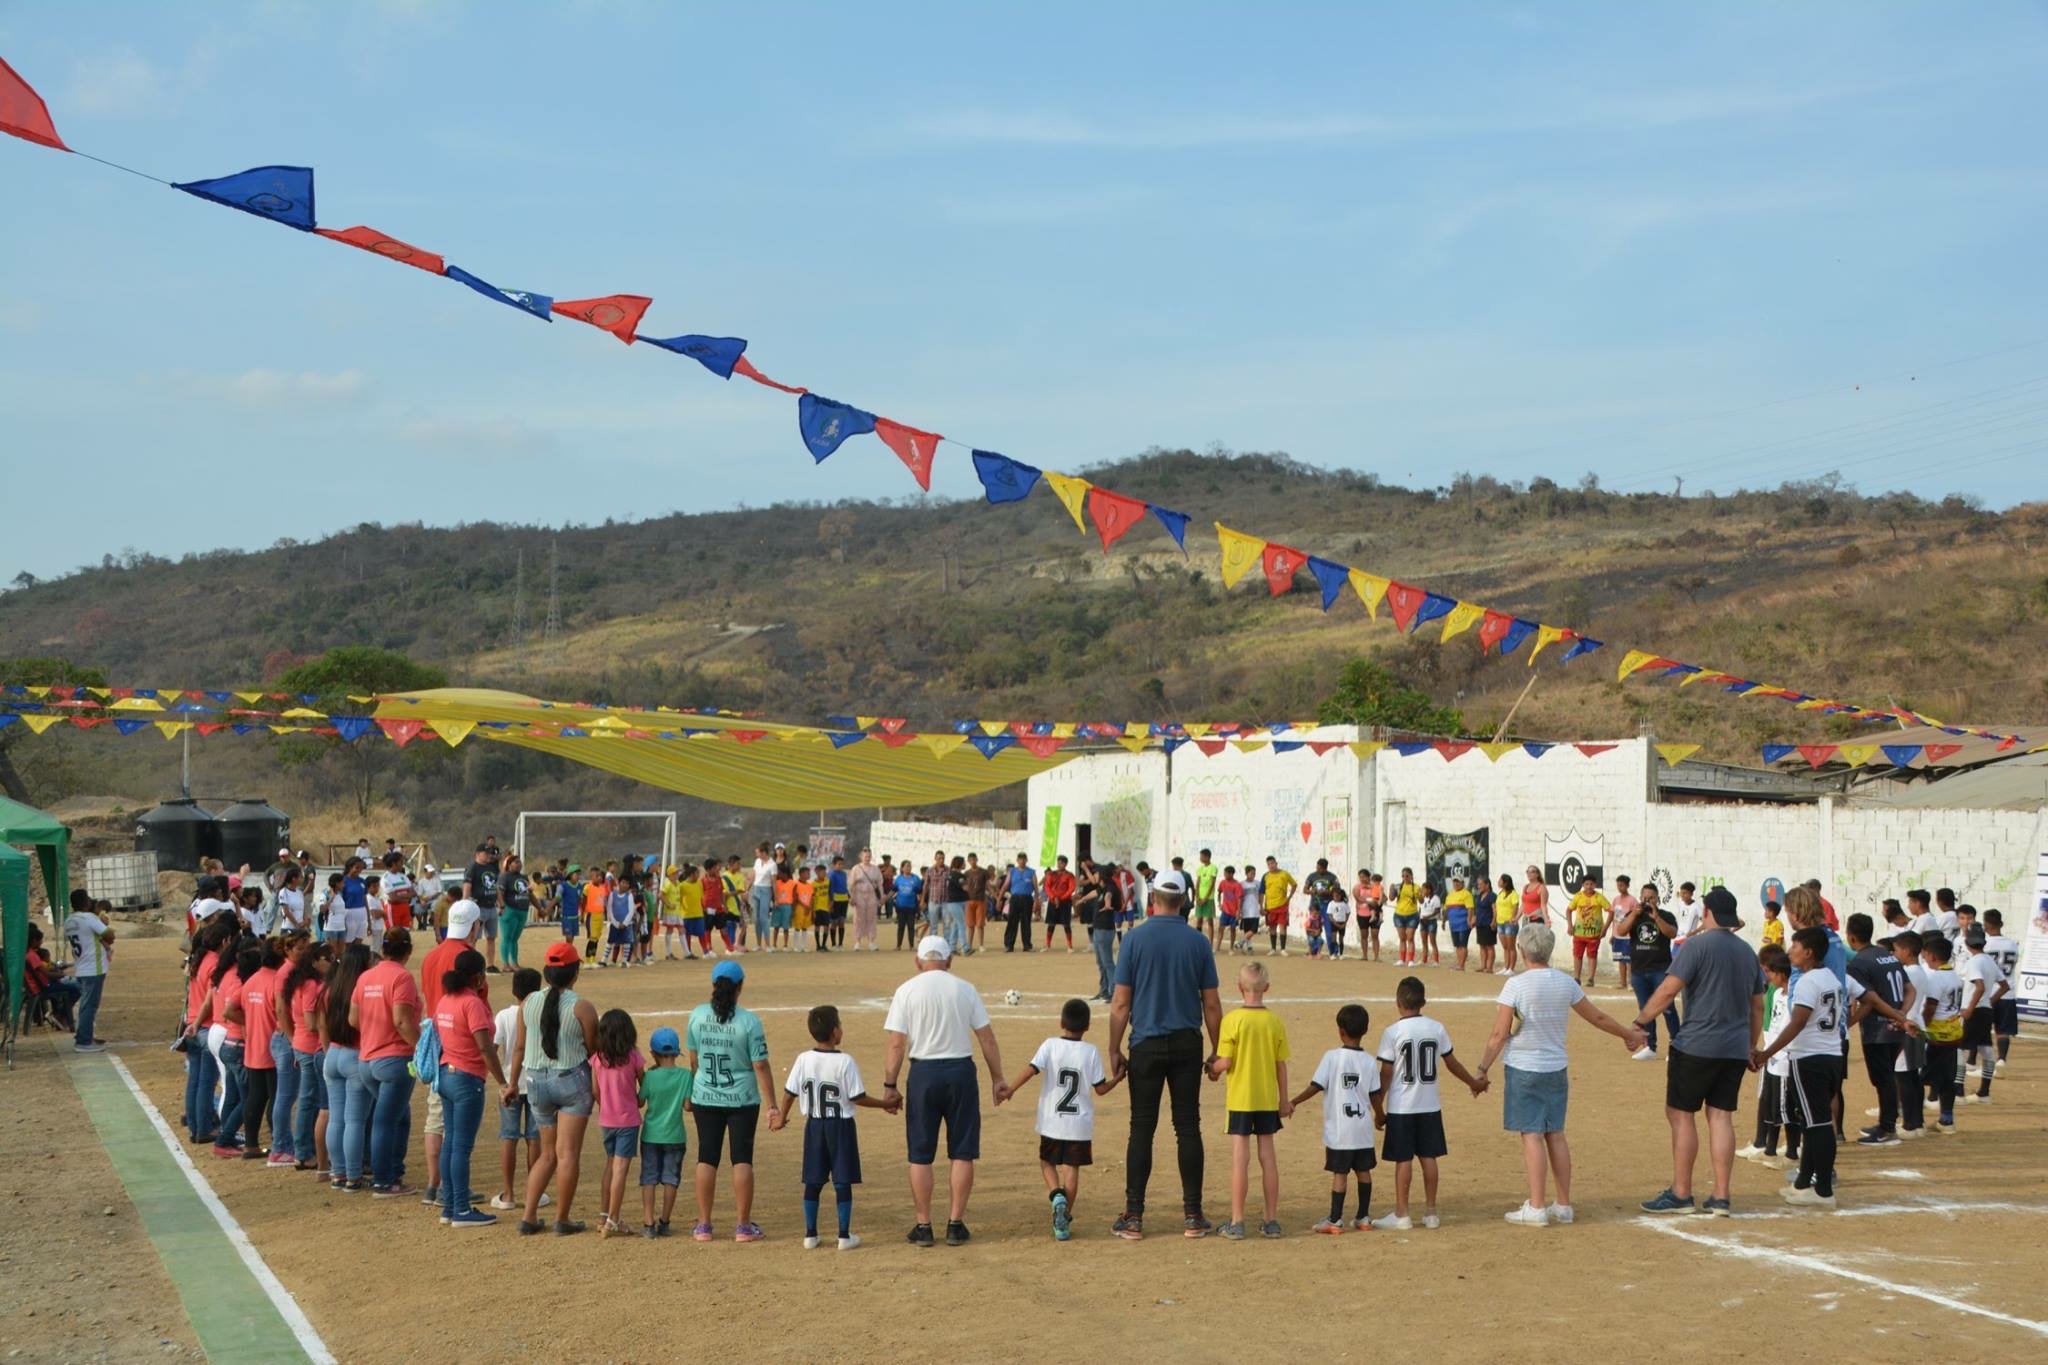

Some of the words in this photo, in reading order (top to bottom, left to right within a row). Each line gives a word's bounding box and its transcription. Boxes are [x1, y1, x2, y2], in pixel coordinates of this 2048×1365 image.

[1566, 864, 1580, 883] SF
[703, 1052, 734, 1088] 35
[1400, 1038, 1439, 1085] 10
[801, 1078, 843, 1118] 16
[1055, 1067, 1081, 1115] 2
